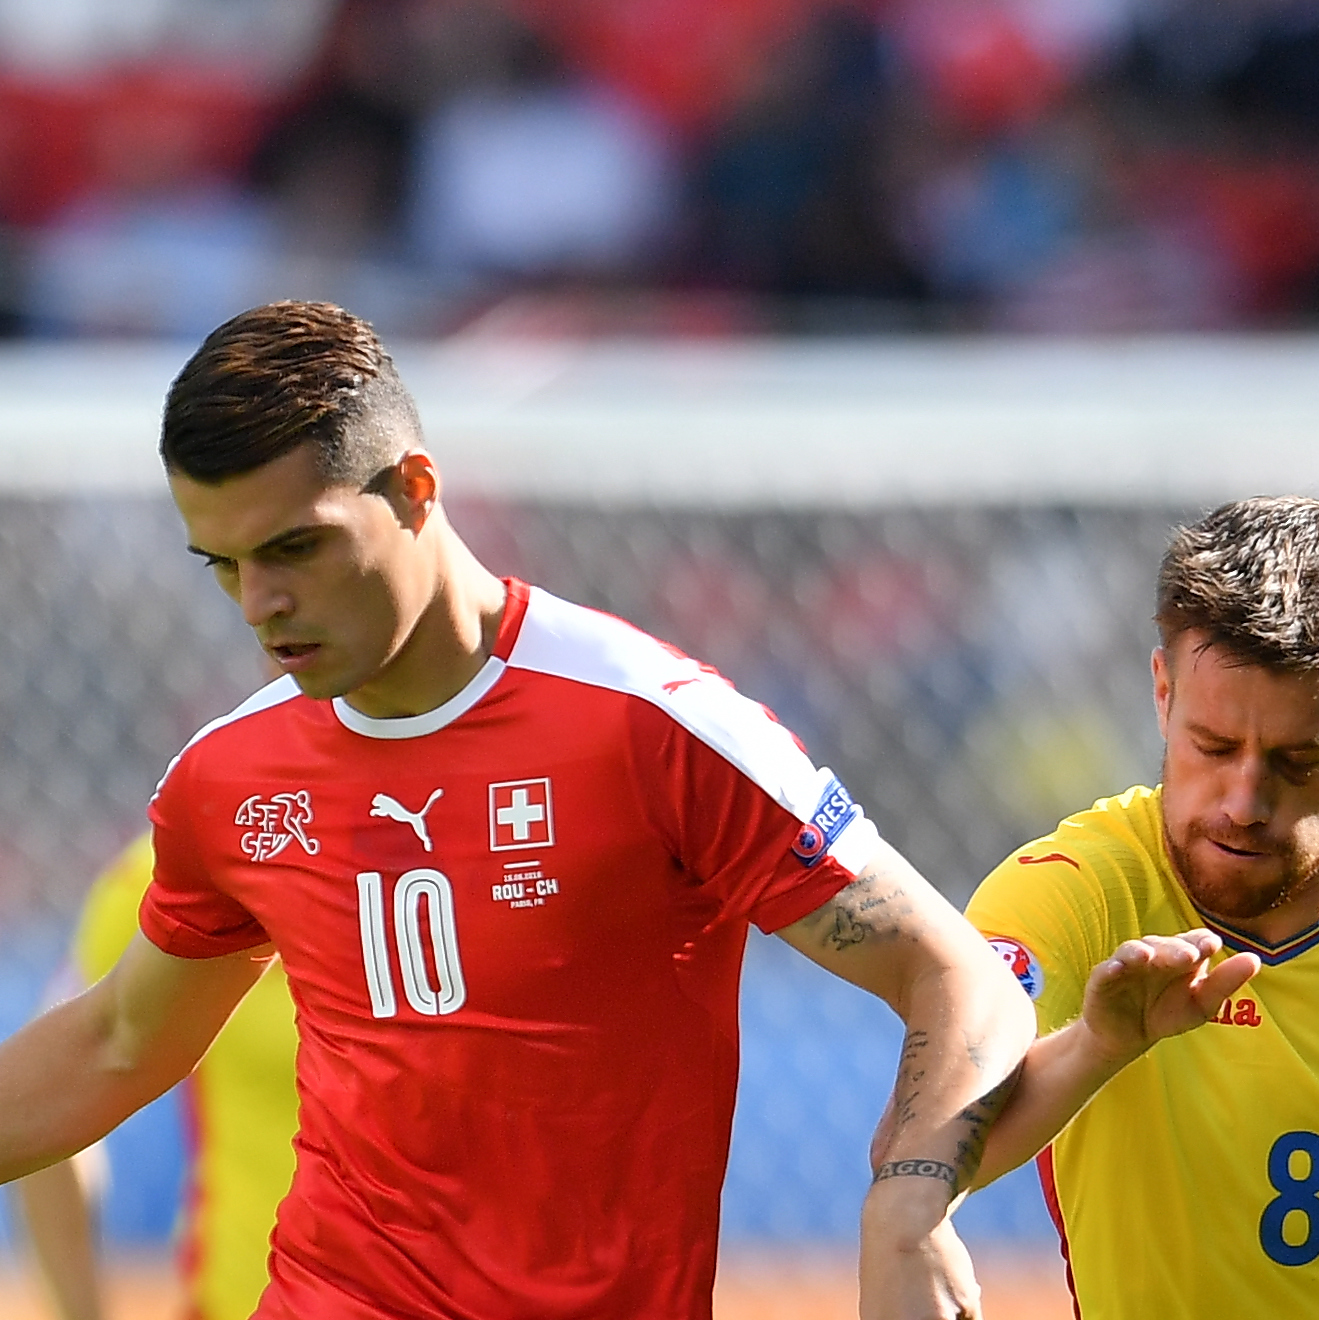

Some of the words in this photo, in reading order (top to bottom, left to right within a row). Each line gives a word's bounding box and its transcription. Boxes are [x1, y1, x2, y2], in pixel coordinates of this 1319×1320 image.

[491, 883, 524, 901] ROU
[536, 878, 559, 896] CH
[356, 868, 467, 1018] 10
